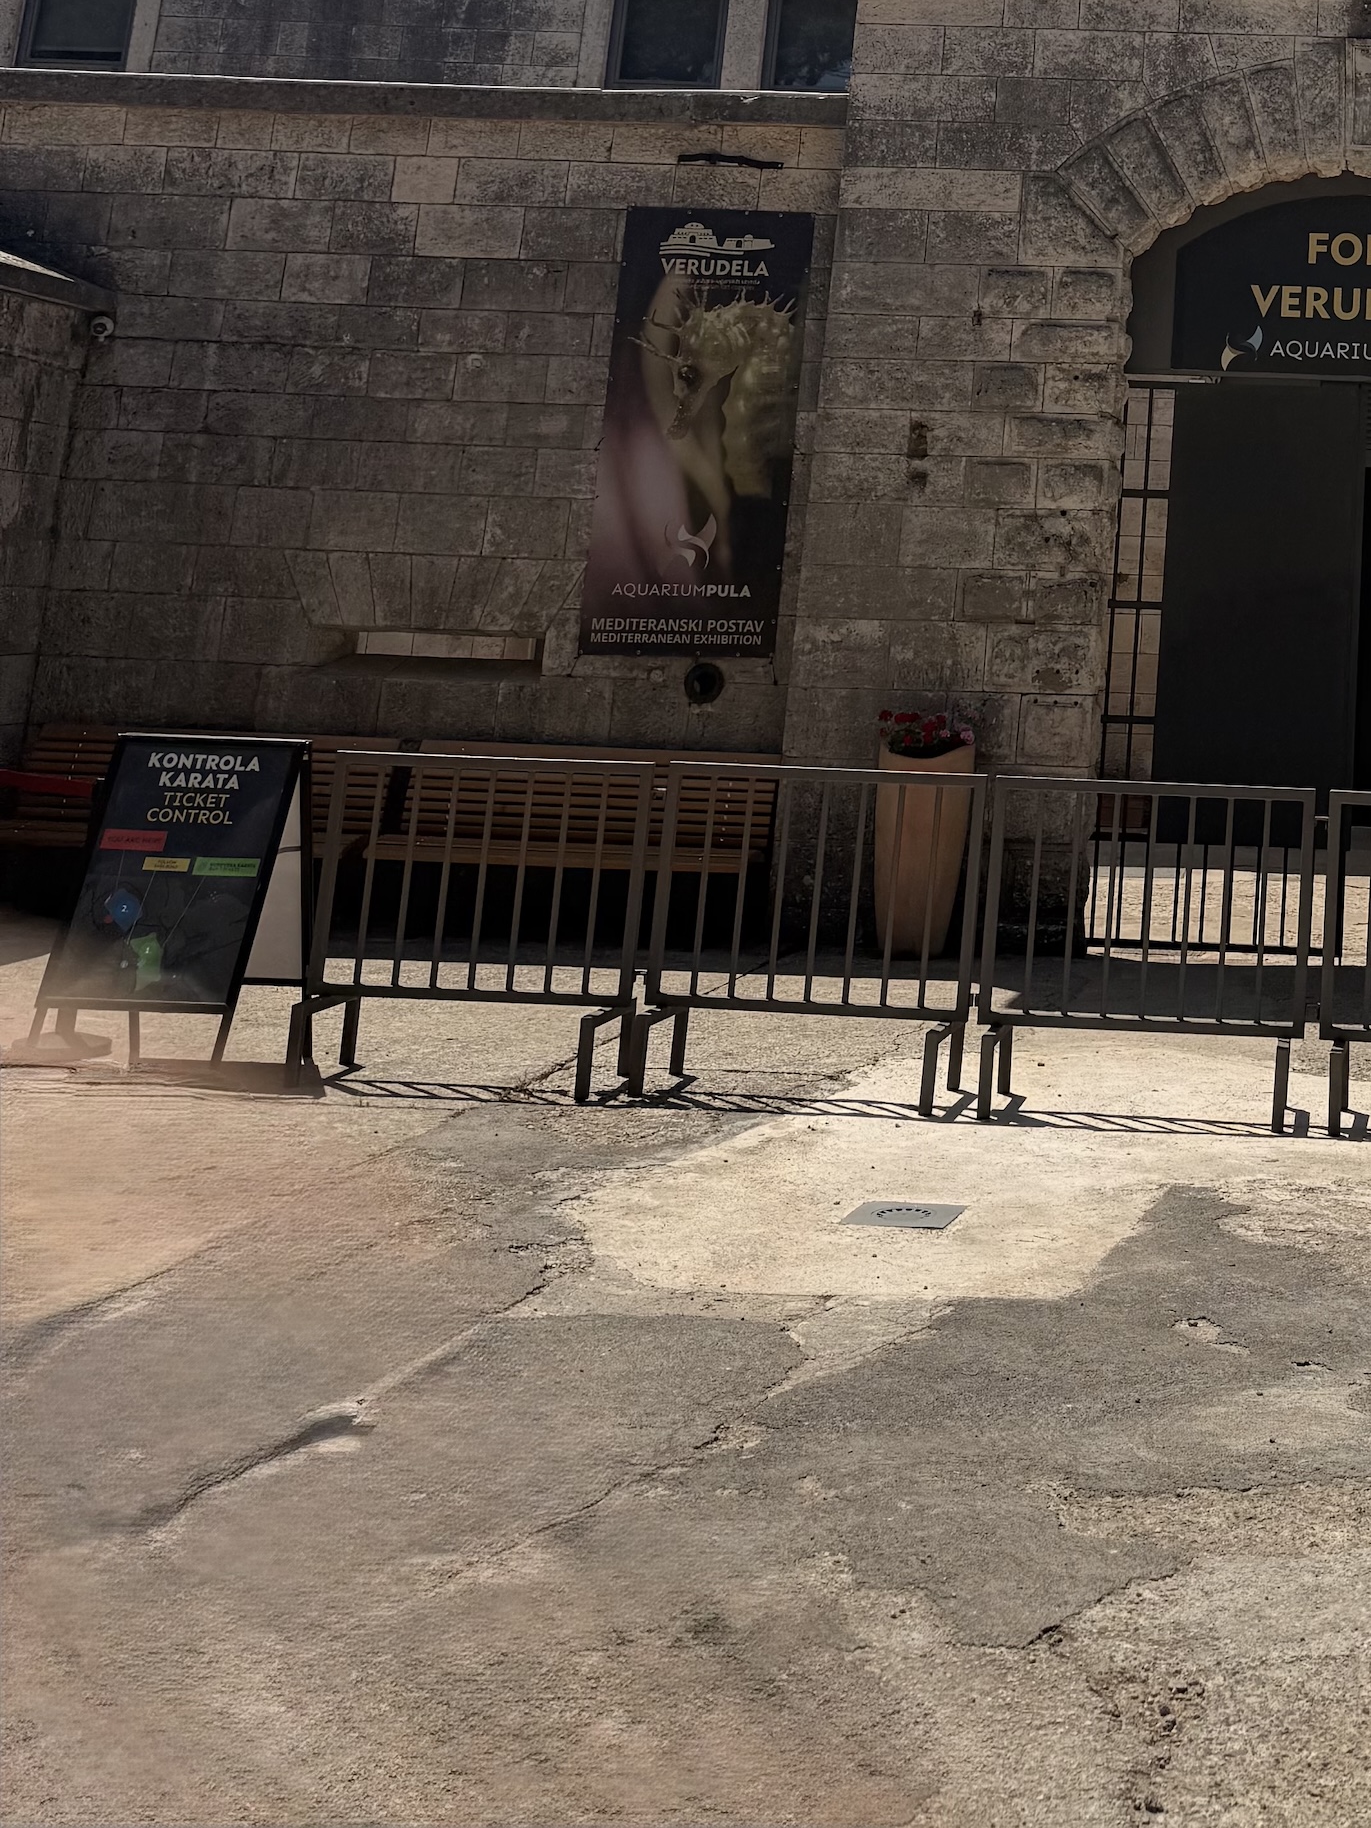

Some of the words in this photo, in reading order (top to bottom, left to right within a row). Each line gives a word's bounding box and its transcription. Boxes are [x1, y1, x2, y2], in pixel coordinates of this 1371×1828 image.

[661, 258, 770, 277] VERUDELA
[611, 582, 752, 598] AQUARIUMPULA
[591, 617, 702, 632] MEDITERANSKI
[706, 619, 765, 633] POSTAV
[590, 632, 691, 644] MEDITERRANEAN
[693, 634, 762, 646] EXHIBITION
[147, 752, 260, 772] KONTROLA
[158, 771, 240, 790] KARATA
[164, 792, 230, 808] TICKET
[146, 807, 233, 825] CONTROL
